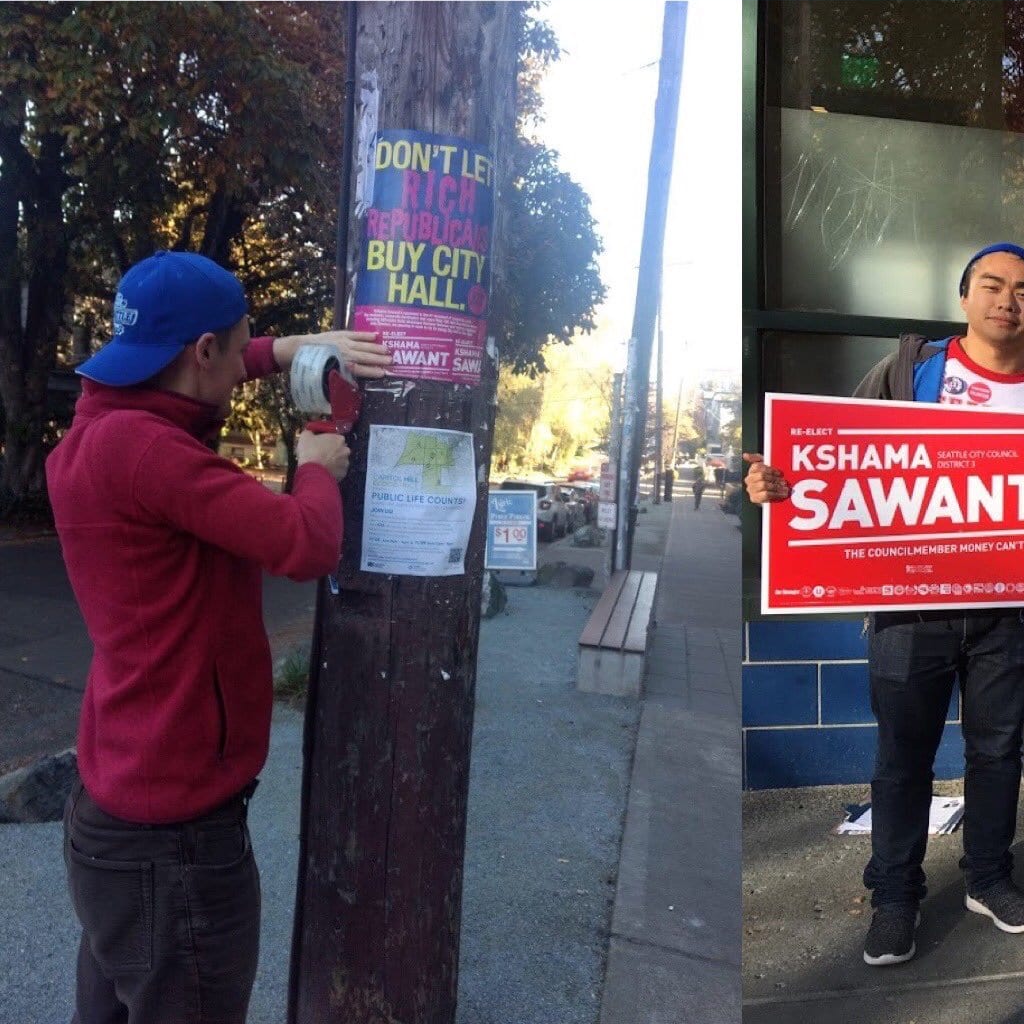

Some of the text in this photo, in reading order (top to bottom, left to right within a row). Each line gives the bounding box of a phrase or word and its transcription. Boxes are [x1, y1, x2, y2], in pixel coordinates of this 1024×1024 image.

[376, 140, 457, 174] DON'T
[402, 170, 476, 214] RICH
[367, 240, 485, 283] BUY CITY
[387, 272, 465, 311] HALL.
[383, 341, 420, 349] KSHAMA
[392, 350, 450, 366] AWANT
[790, 428, 833, 436] RE-ELECT
[792, 444, 932, 471] KSHAMA
[937, 450, 1018, 459] SEATTLE CITY COUNCIL
[937, 460, 968, 468] DISTRICT
[371, 493, 403, 502] PUBLIC
[407, 494, 424, 503] LIFE
[845, 548, 865, 559] THE
[868, 544, 956, 558] COUNCILMEMBER
[960, 542, 994, 552] MONEY
[996, 541, 1023, 552] CAN'T
